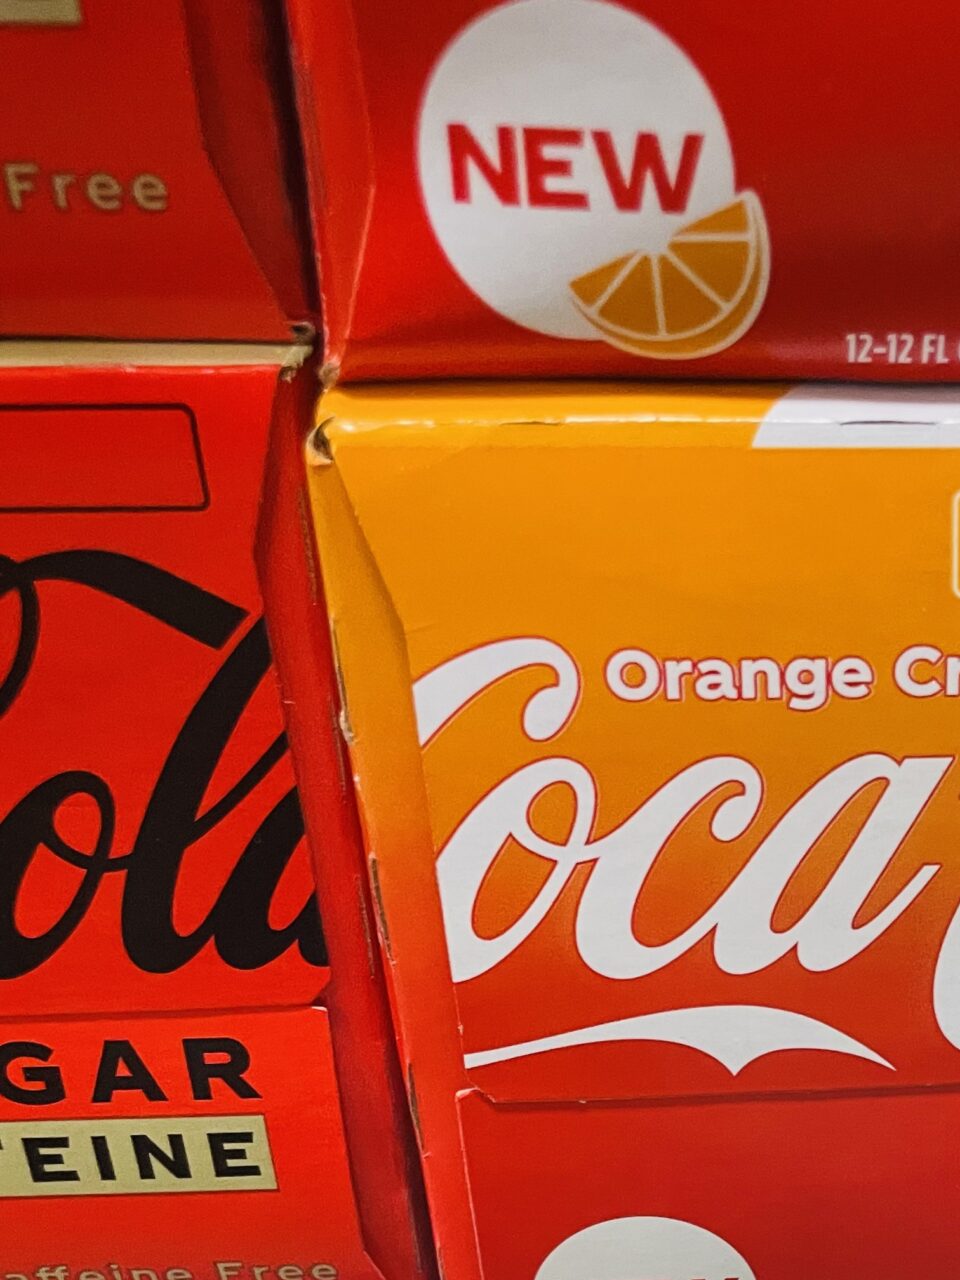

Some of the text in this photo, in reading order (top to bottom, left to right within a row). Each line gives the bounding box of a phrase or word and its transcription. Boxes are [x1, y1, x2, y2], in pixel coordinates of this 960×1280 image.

[3, 162, 169, 212] Free
[447, 122, 704, 214] NEW
[844, 334, 914, 364] 12-12
[921, 334, 948, 364] FL
[605, 646, 873, 711] Orange
[0, 1131, 262, 1183] EINE
